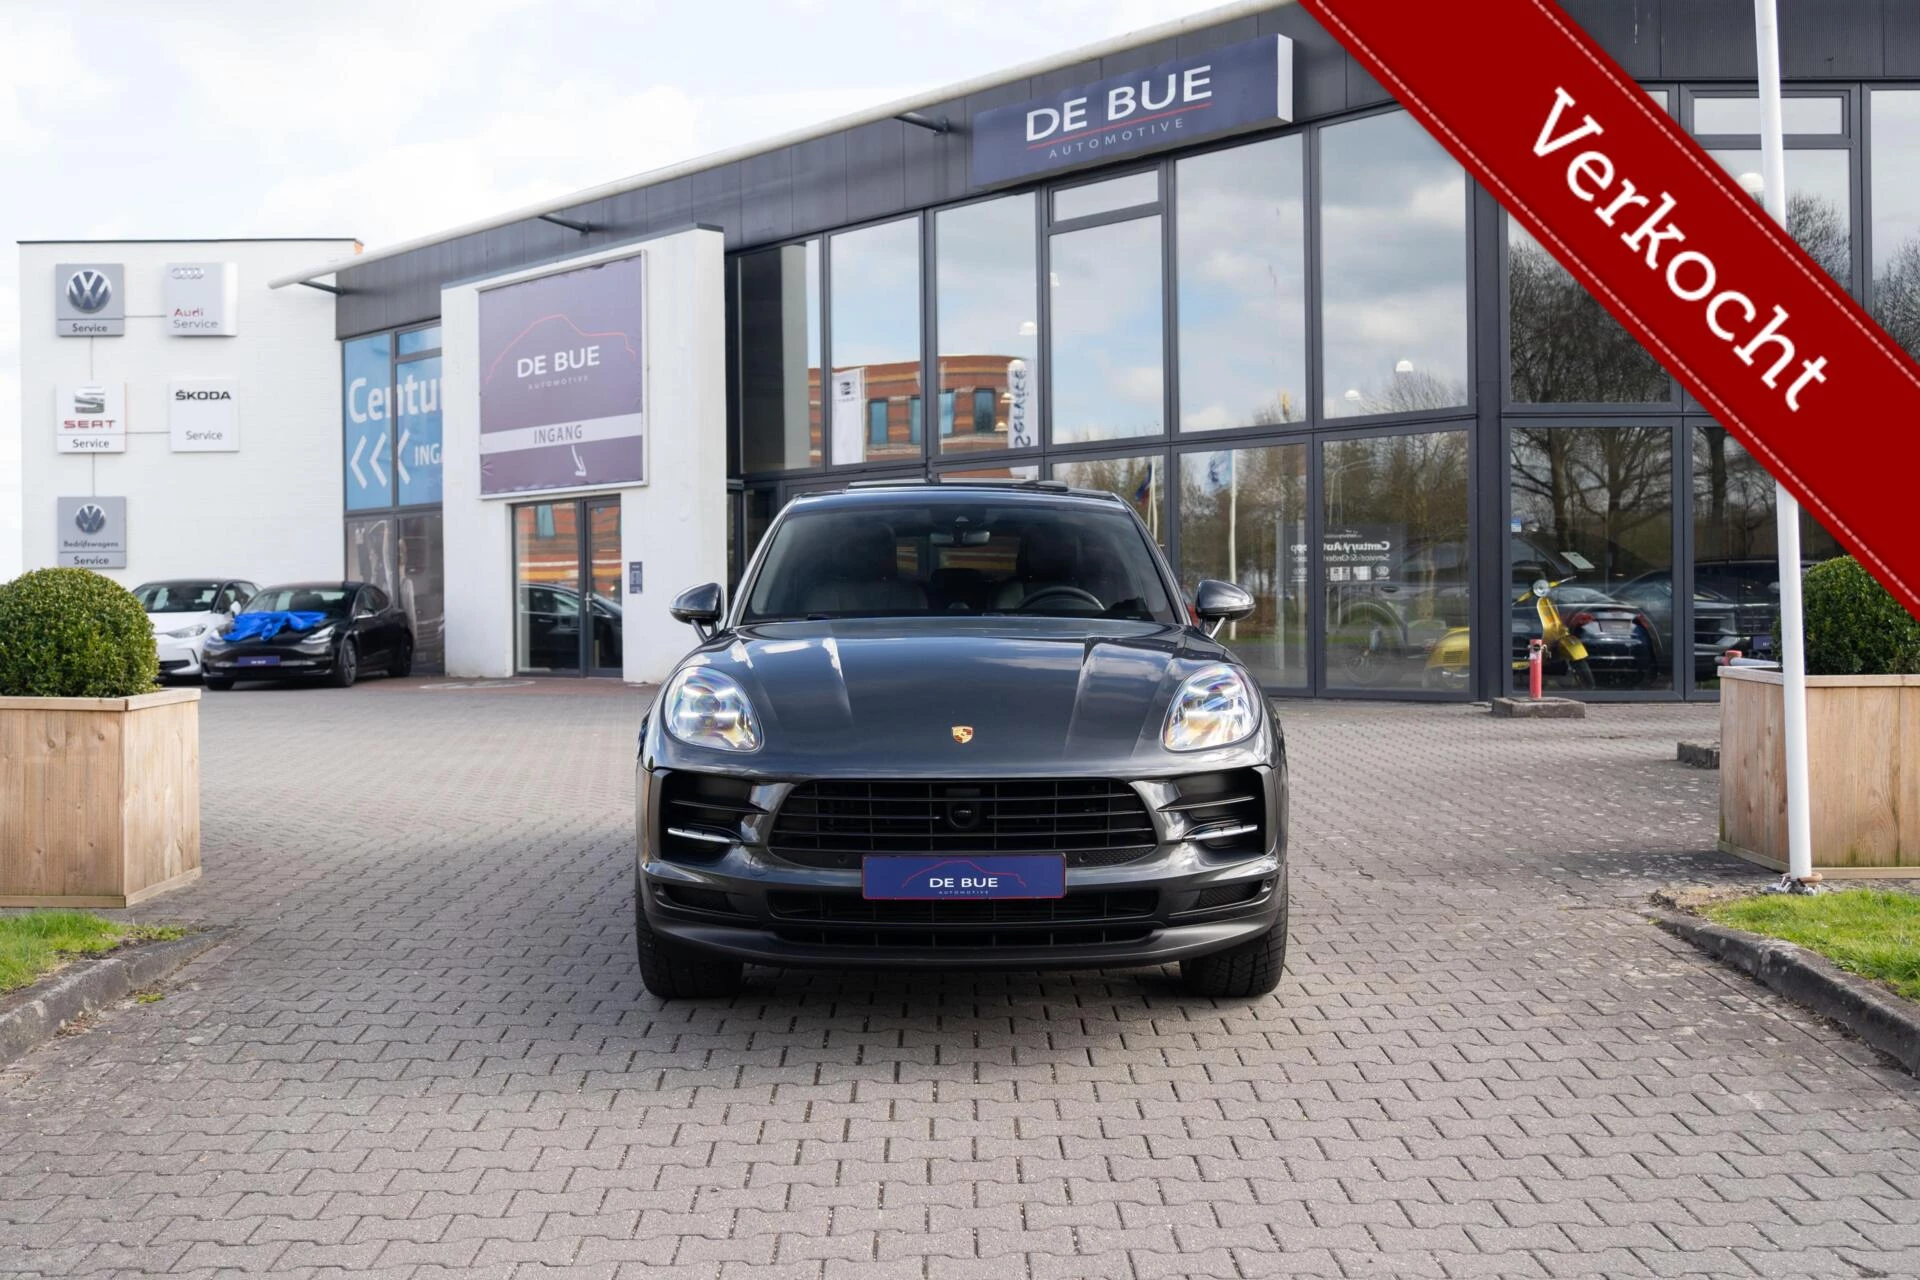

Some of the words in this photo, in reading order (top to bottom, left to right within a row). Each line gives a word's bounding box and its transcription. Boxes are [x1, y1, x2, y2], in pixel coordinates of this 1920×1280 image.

[1025, 96, 1088, 142] DE
[1107, 64, 1212, 121] BUE
[1048, 117, 1184, 160] AUTOMOTIVE
[174, 307, 204, 317] Audi
[72, 323, 108, 333] Service
[173, 319, 218, 329] Service
[517, 355, 547, 378] DE
[554, 345, 600, 372] BUE
[175, 389, 231, 401] ŠKODA
[348, 374, 444, 424] Centu
[64, 420, 116, 429] SEAT
[185, 430, 223, 441] Service
[533, 423, 582, 444] INGANG
[72, 438, 110, 448] Service
[414, 443, 443, 466] ING
[73, 555, 109, 565] Service
[929, 877, 955, 888] DE
[961, 877, 998, 888] BUE
